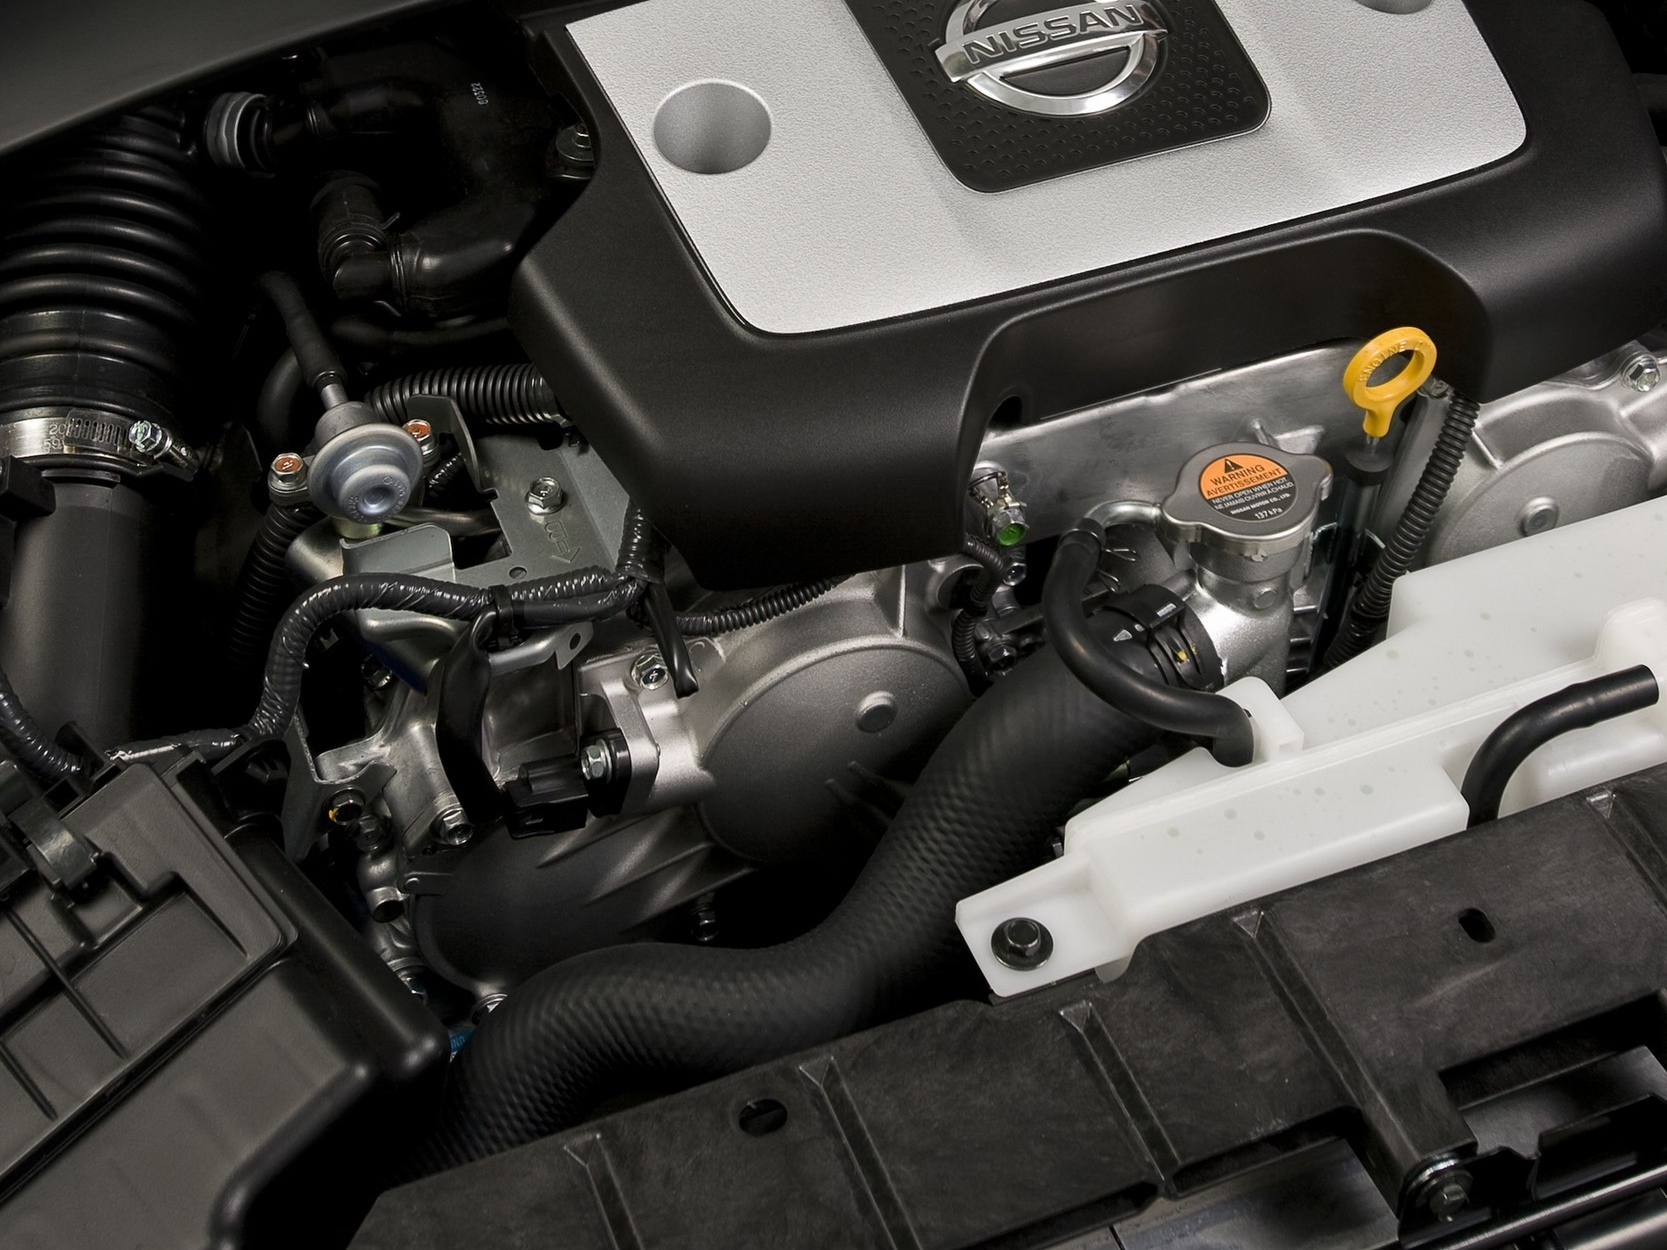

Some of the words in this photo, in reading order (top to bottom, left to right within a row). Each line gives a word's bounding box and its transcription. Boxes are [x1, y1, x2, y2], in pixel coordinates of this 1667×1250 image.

[962, 5, 1144, 65] NISSAN
[1206, 468, 1282, 497] AVERTISSEMENT
[1210, 464, 1265, 486] WARNING
[1212, 494, 1234, 504] NEVER
[1234, 488, 1253, 498] OPEN
[1252, 482, 1273, 492] WHEN
[1223, 497, 1245, 508] JAMAIS
[1245, 491, 1267, 501] OUVRIR
[1271, 481, 1294, 493] CHAUD
[1230, 505, 1251, 515] NISSAN
[1250, 499, 1269, 509] MOTOR
